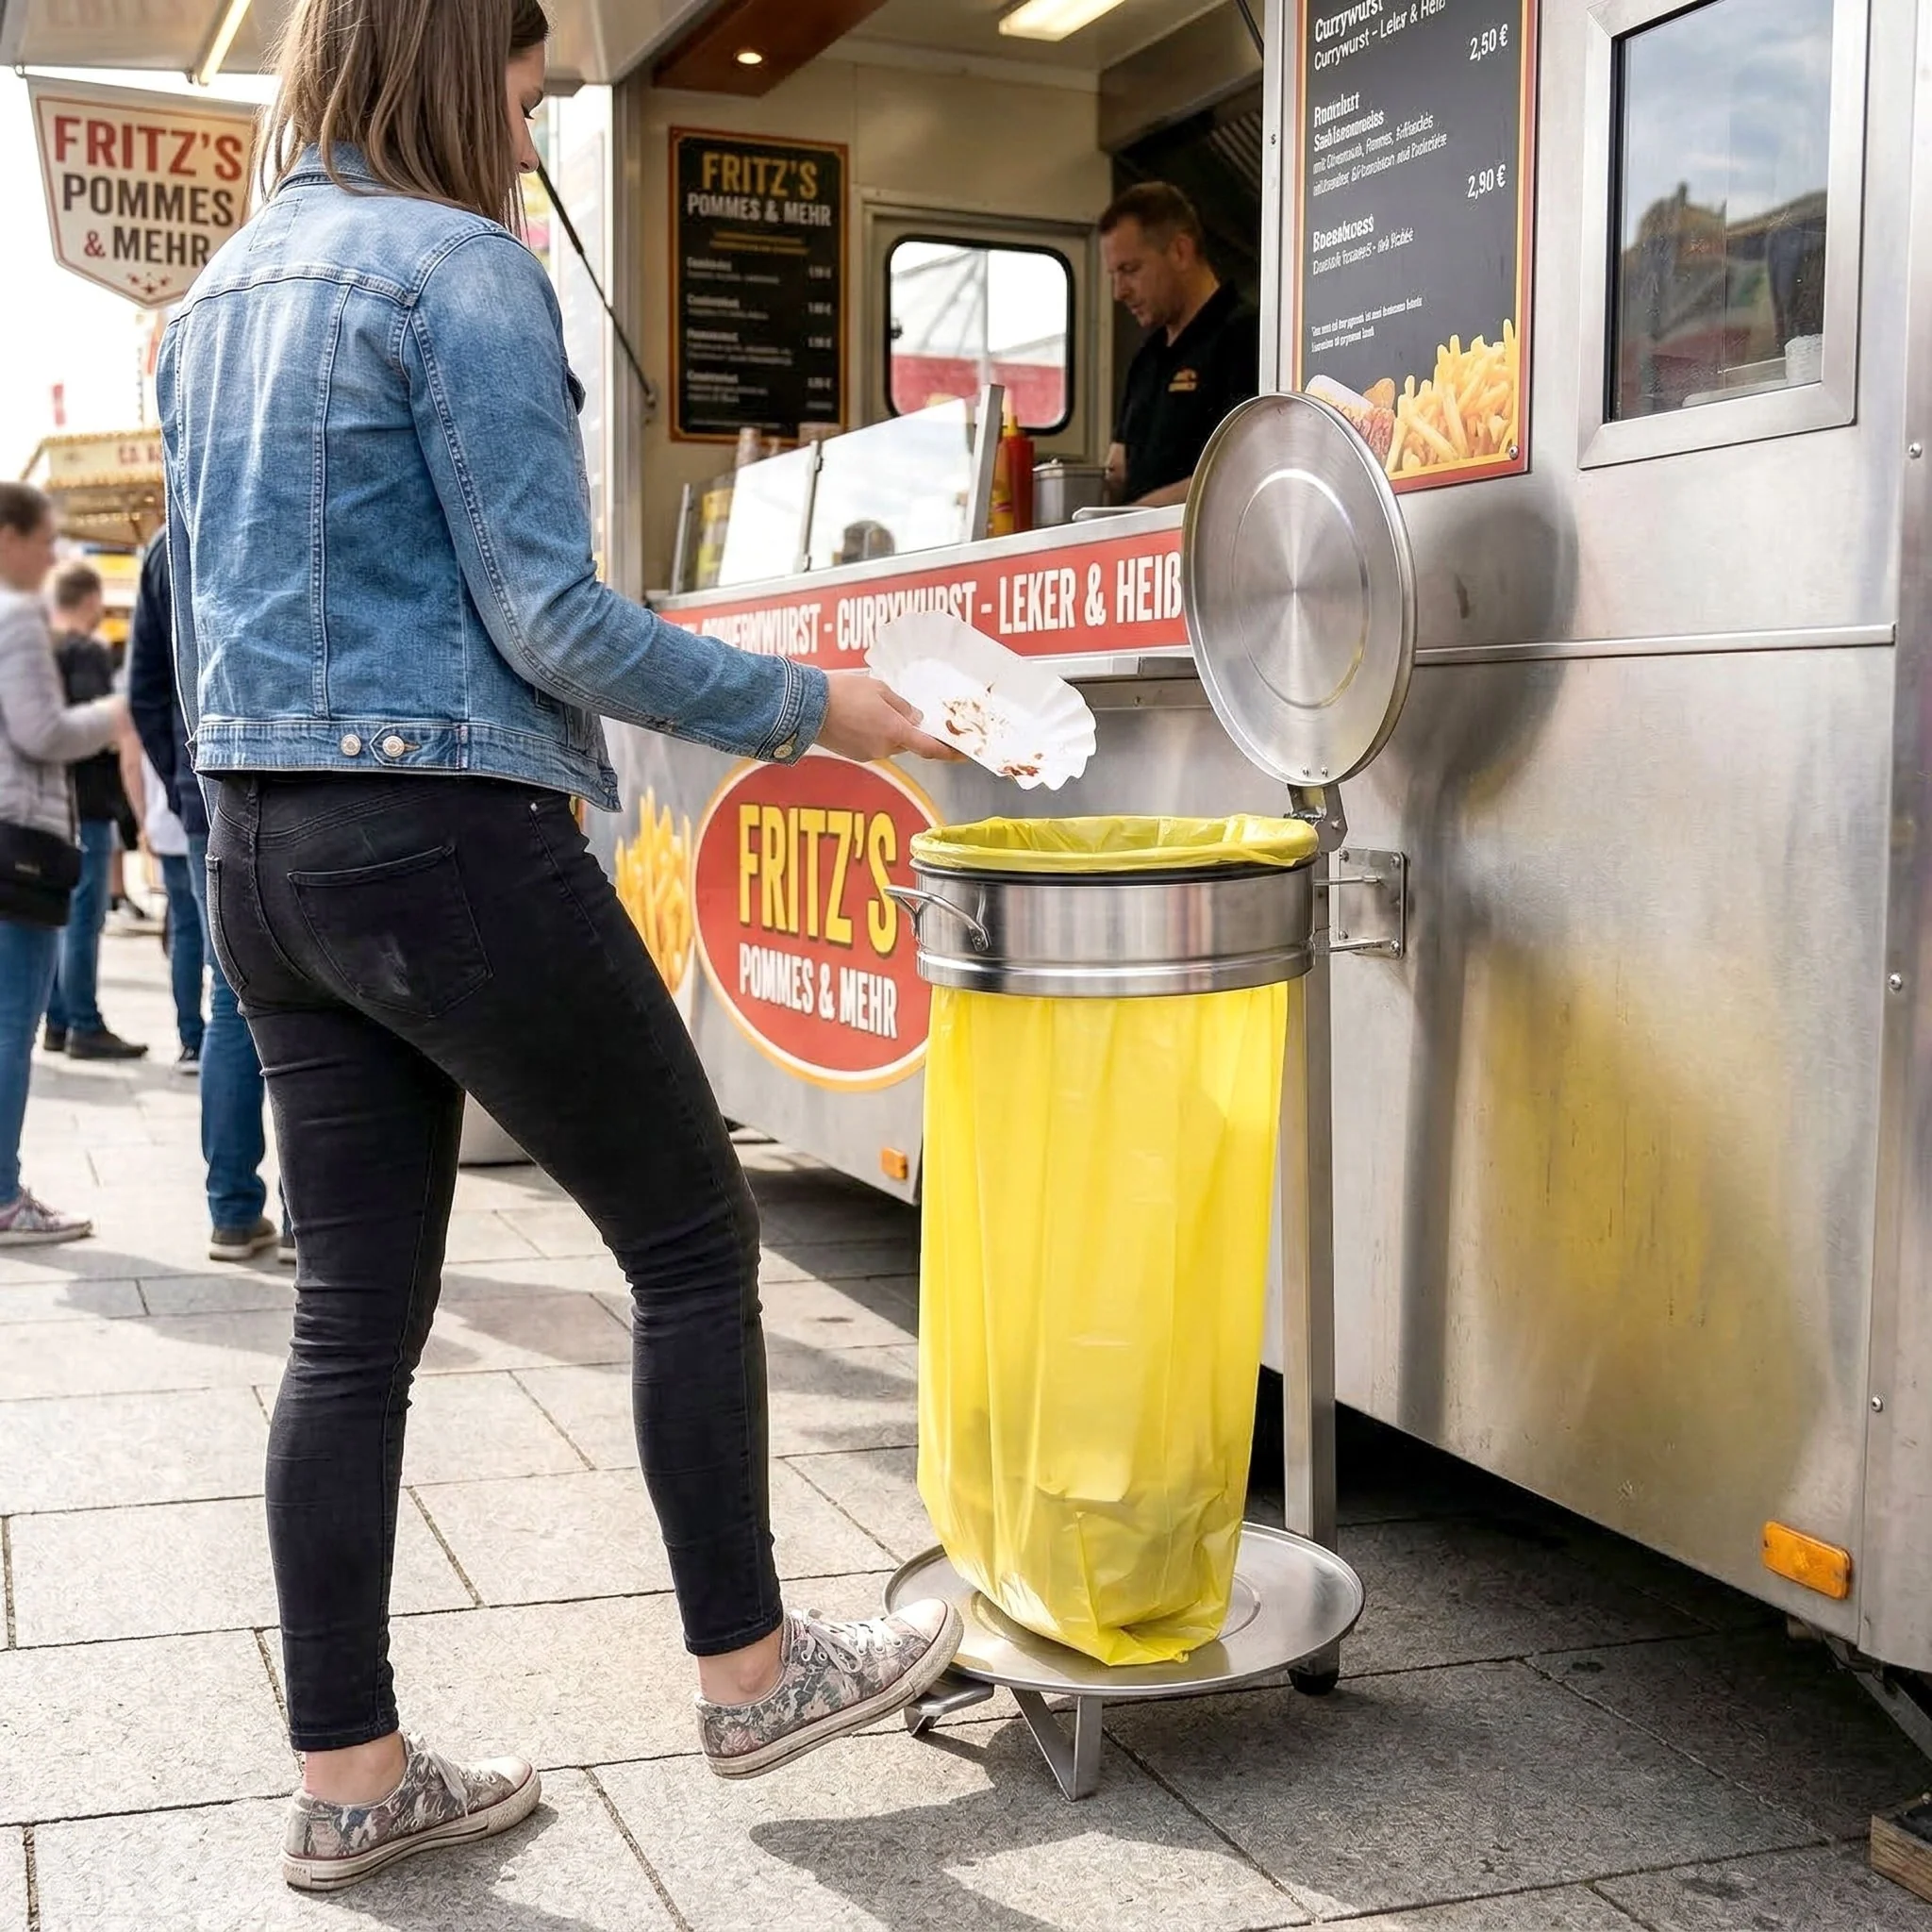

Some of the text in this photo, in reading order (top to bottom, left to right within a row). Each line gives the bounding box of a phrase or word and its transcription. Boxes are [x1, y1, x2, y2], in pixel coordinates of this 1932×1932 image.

[1314, 28, 1370, 71] Currywurst
[1409, 3, 1418, 24] &
[1470, 24, 1508, 60] 2,50 €
[55, 114, 243, 182] FRITZ'S
[63, 173, 235, 227] POMMES
[702, 151, 818, 200] FRITZ'S
[1467, 164, 1507, 199] 2,90 €
[687, 192, 831, 226] POMMES & MEHR
[84, 225, 211, 268] & MEHR
[999, 567, 1075, 634] LEKER
[1085, 563, 1107, 626] &
[739, 804, 898, 955] FRITZ'S
[740, 942, 898, 1039] POMMES & MEHR
